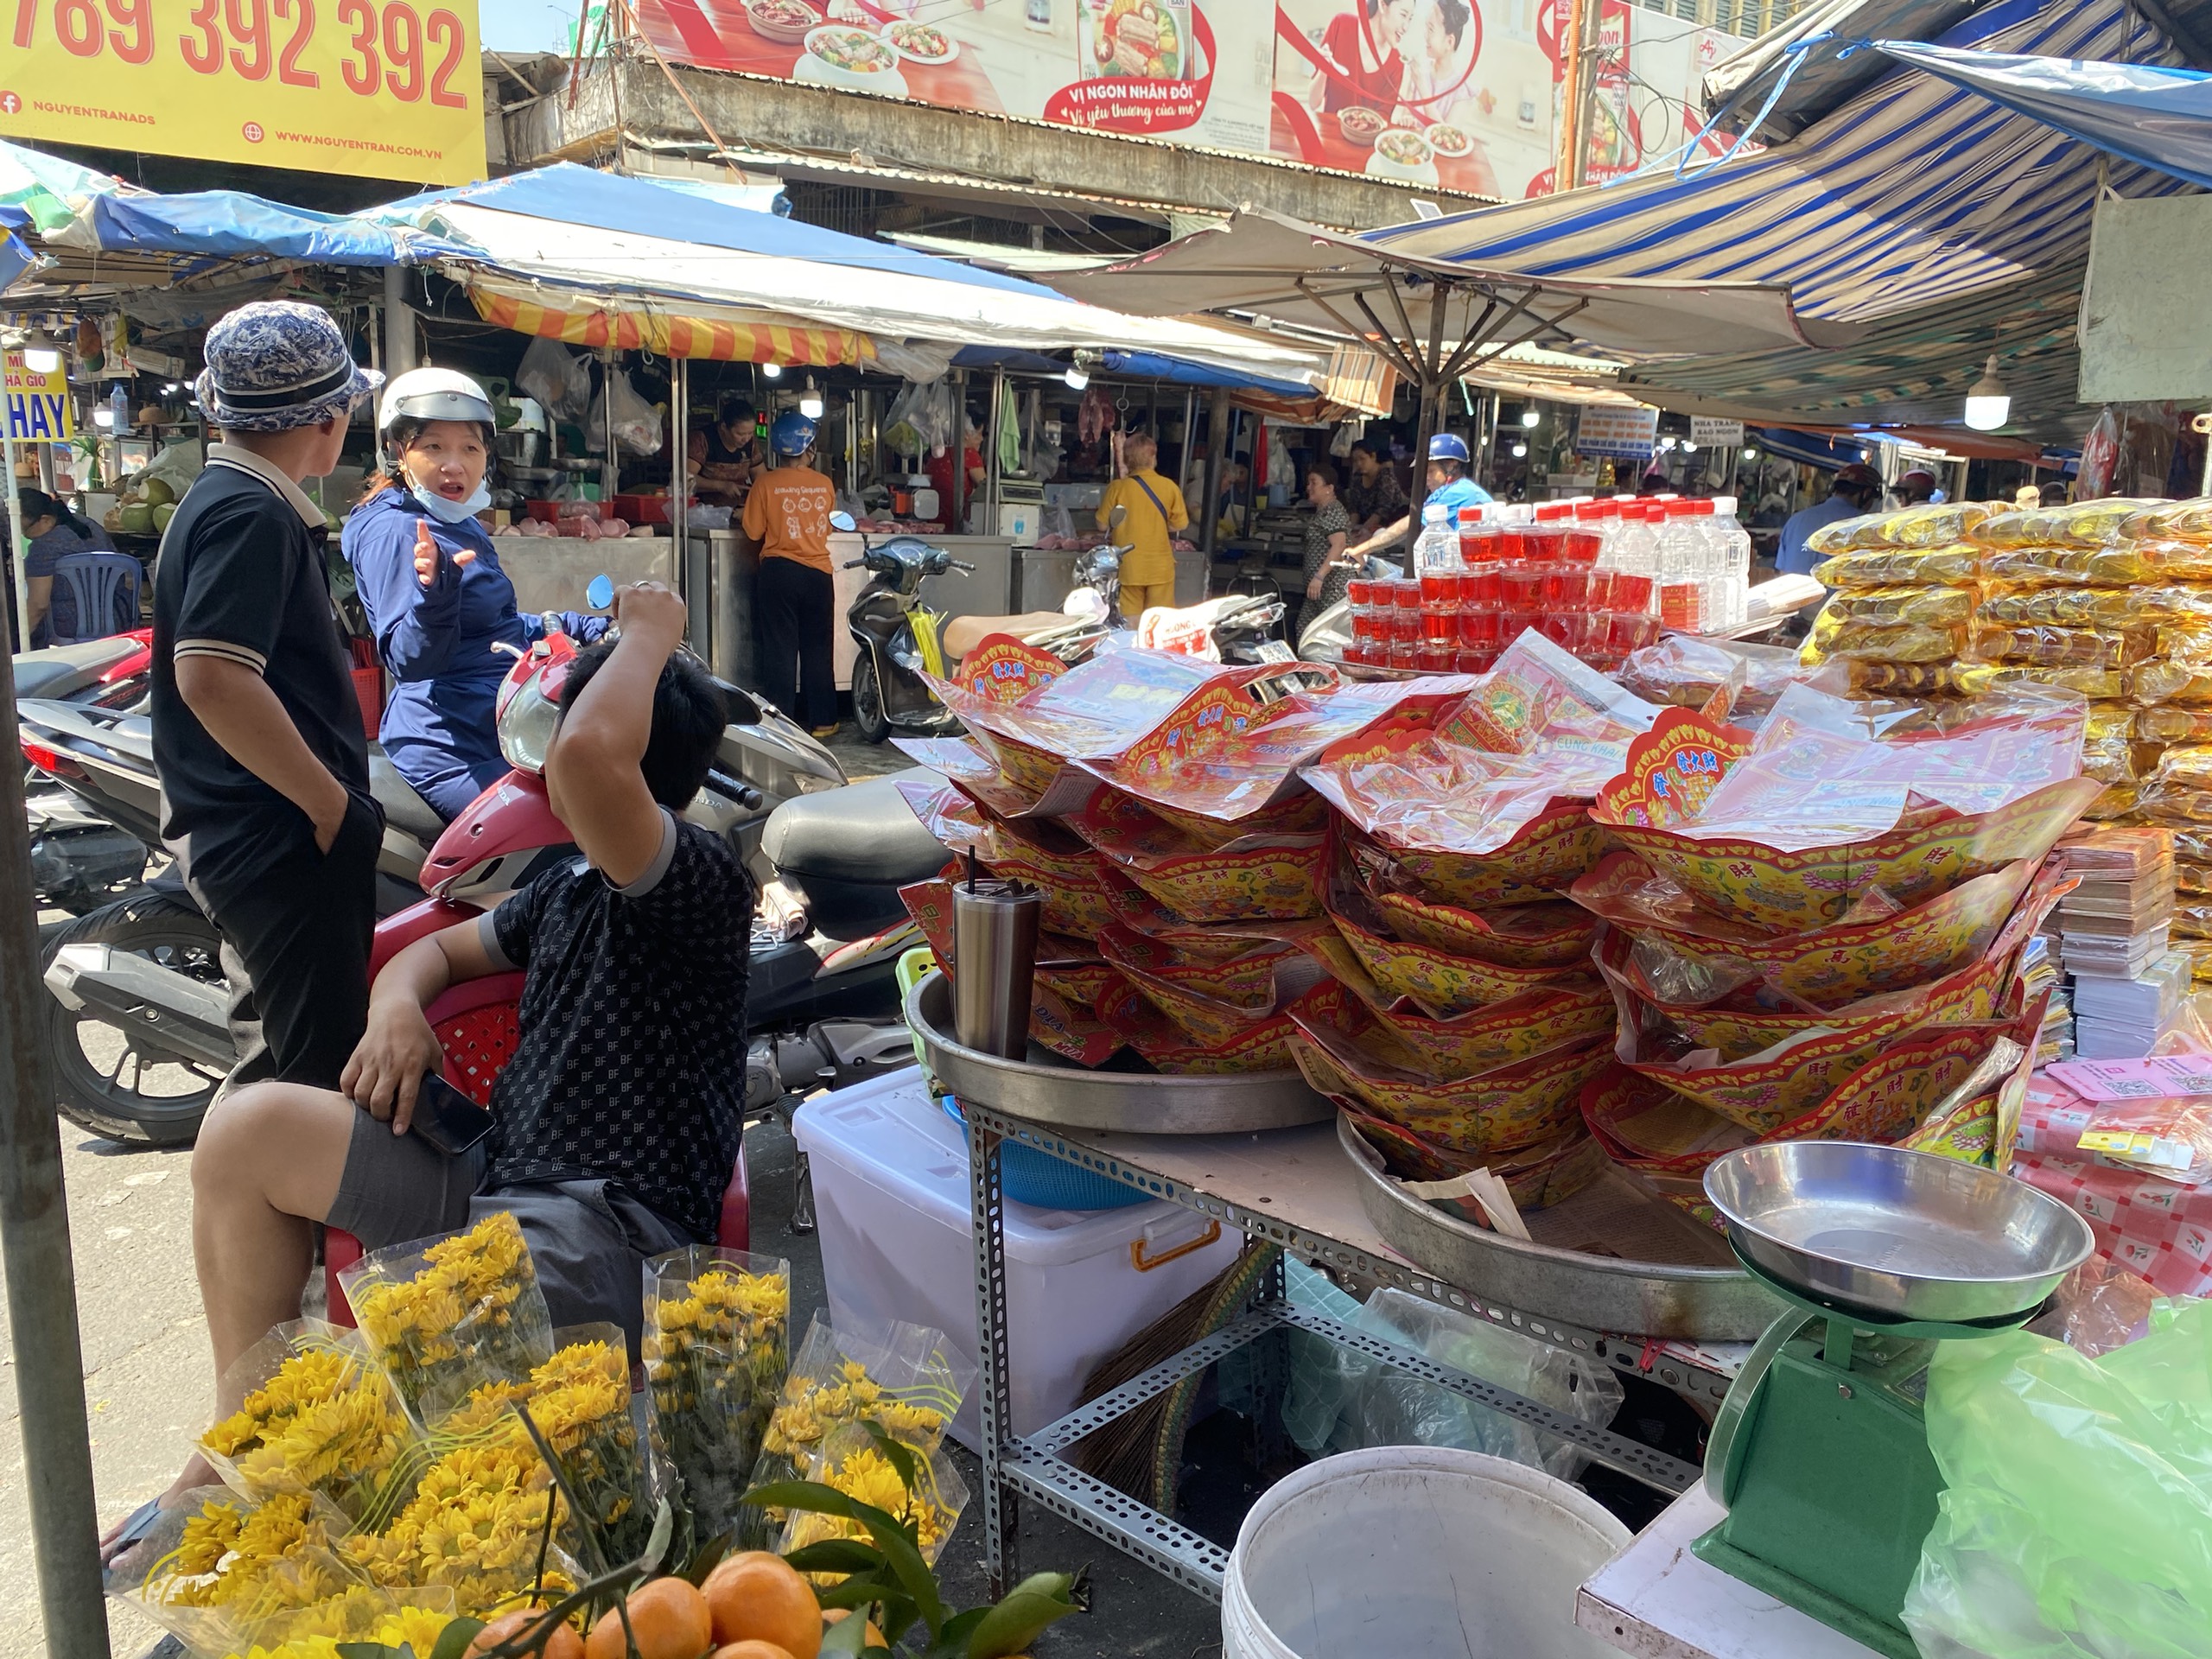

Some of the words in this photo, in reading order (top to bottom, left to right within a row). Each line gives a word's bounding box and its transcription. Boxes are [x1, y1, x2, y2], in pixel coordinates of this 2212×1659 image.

[180, 0, 320, 89] 392
[338, 0, 467, 110] 392
[1069, 89, 1084, 105] VỊ
[1087, 85, 1127, 100] NGON
[1129, 82, 1167, 100] NHÂN
[1170, 82, 1193, 100] ĐÔI
[33, 100, 156, 125] NGUYENTRANADS
[1087, 105, 1109, 128] yêu
[1154, 100, 1175, 117] của
[1178, 105, 1196, 118] mẹ
[275, 130, 442, 160] WWW.NGUYENTRAN.COM.VN
[5, 371, 22, 387] HẢ
[7, 393, 65, 438] HAY
